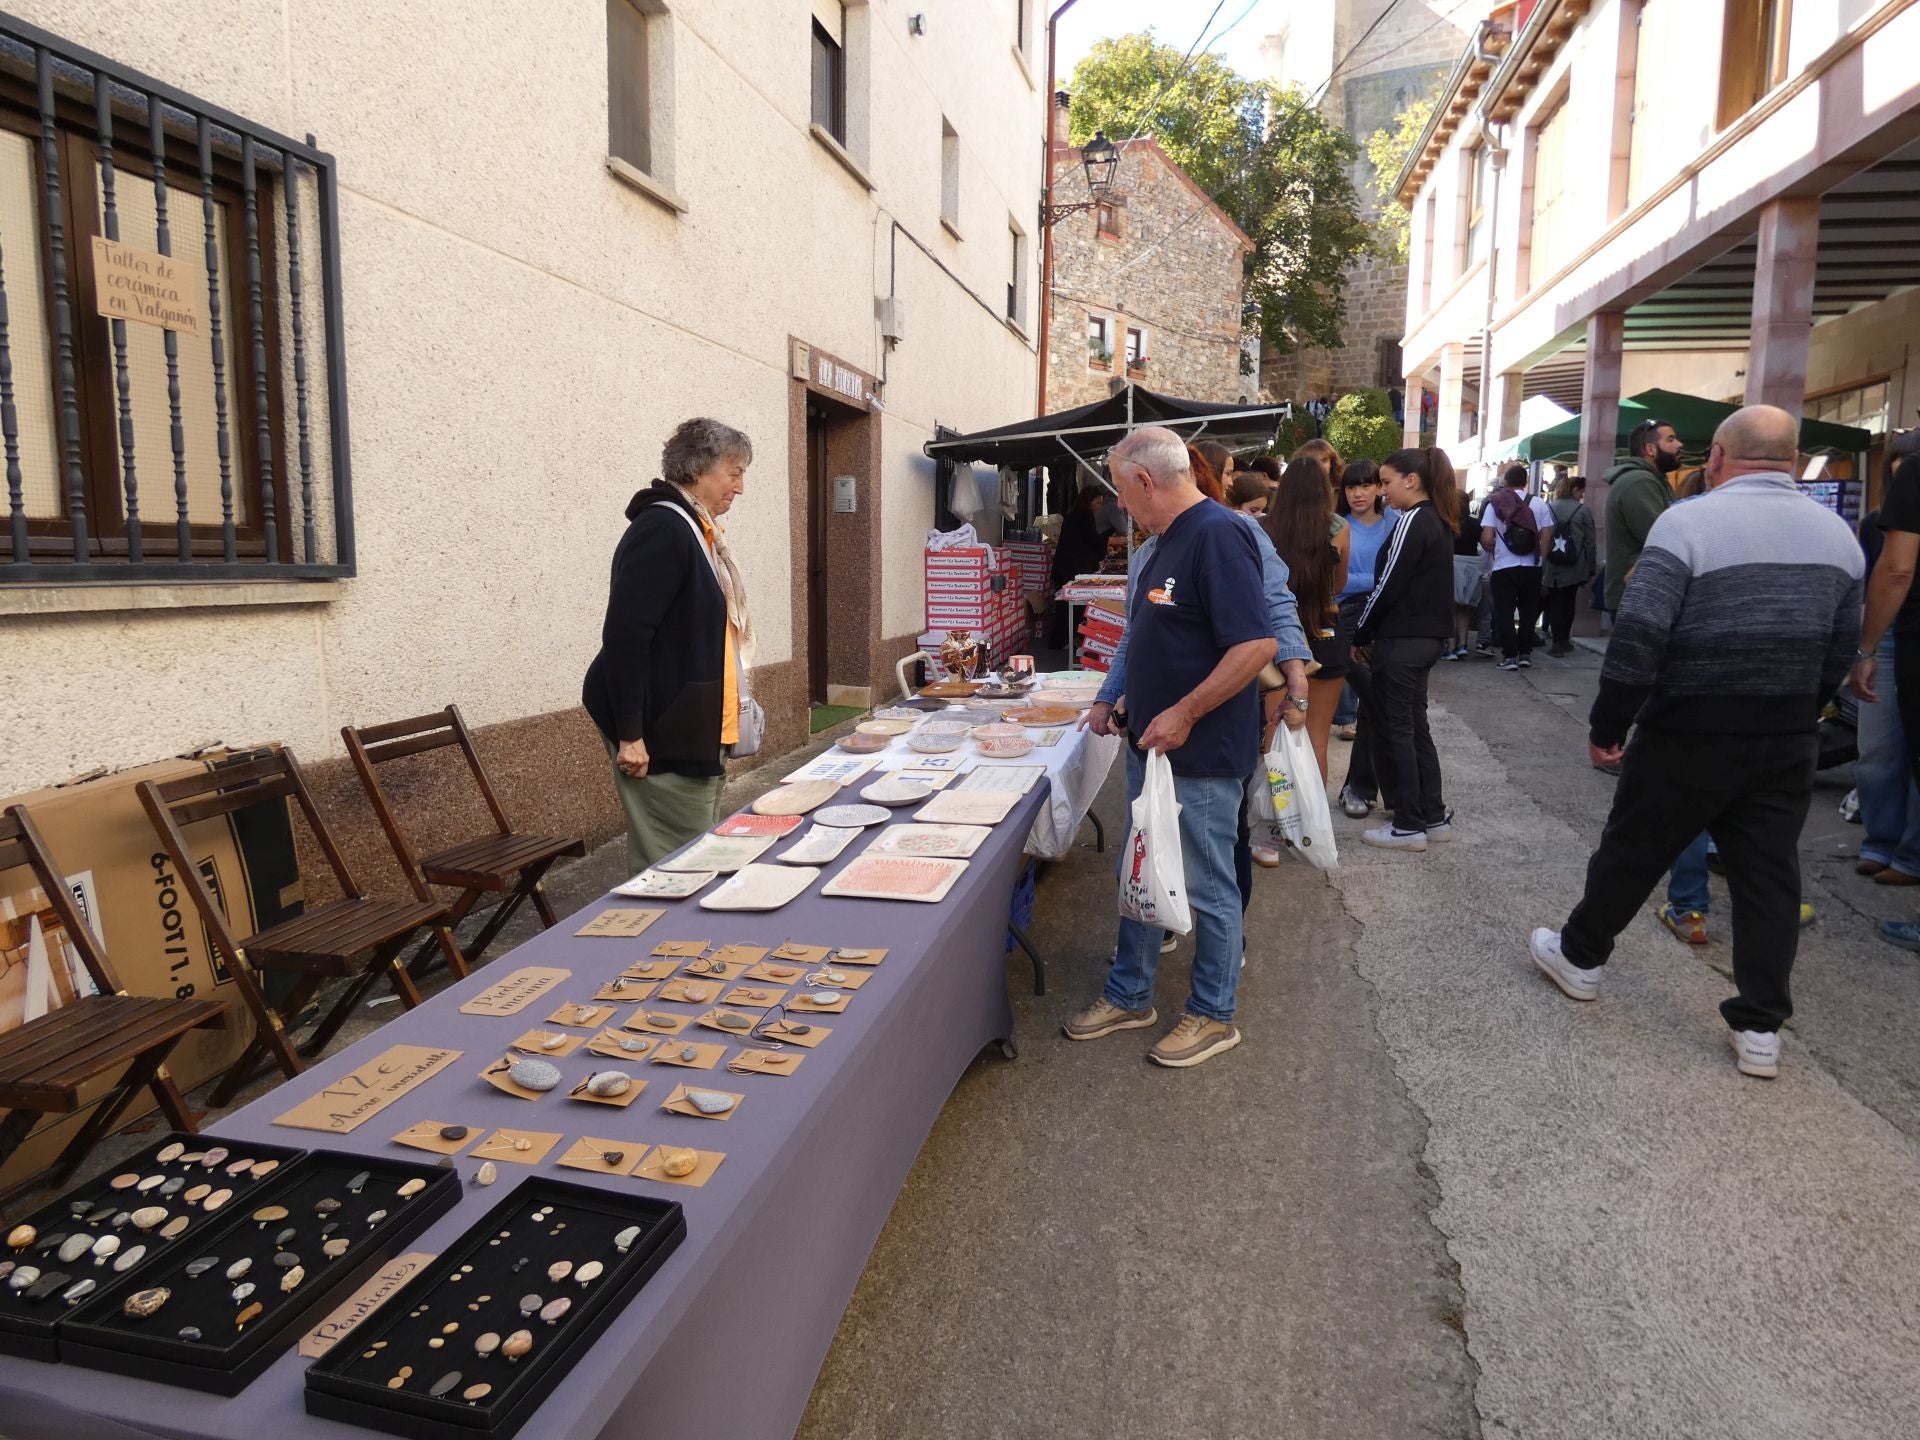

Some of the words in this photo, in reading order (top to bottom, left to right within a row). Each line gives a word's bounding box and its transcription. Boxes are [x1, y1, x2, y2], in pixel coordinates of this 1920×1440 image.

[96, 241, 150, 274] Taller
[157, 260, 176, 281] de
[107, 273, 180, 302] cerámica
[109, 295, 129, 312] en
[131, 293, 198, 330] Valgañón
[471, 976, 530, 1008] Piedra
[498, 976, 554, 1010] marina
[322, 1074, 382, 1100] 12
[377, 1061, 406, 1077] €
[329, 1096, 382, 1128] Acero
[381, 1050, 451, 1093] inoxidable
[312, 1261, 417, 1347] Pendientes
